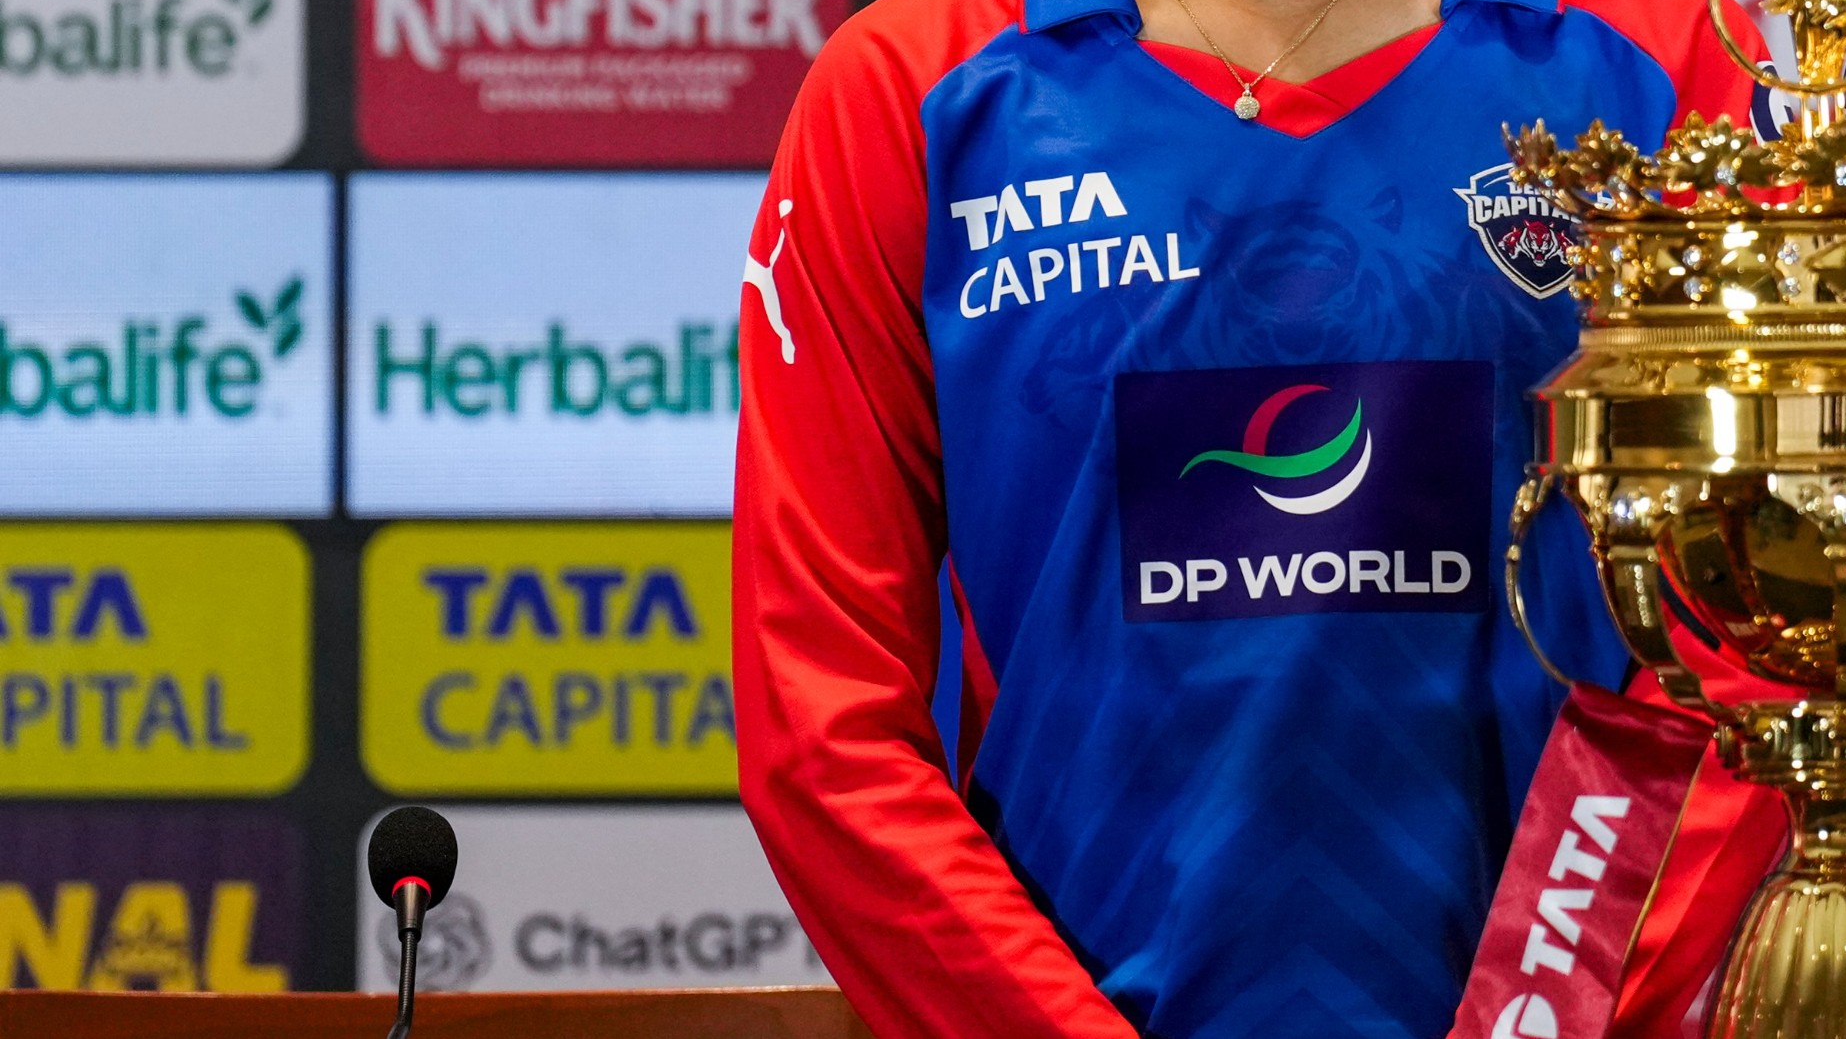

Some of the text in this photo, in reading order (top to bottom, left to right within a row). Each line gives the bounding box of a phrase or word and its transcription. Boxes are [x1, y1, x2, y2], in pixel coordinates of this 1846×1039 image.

[951, 171, 1128, 251] TATA
[959, 232, 1201, 319] CAPITAL
[374, 318, 739, 418] Herbali
[0, 566, 150, 643] TA
[424, 566, 699, 642] TATA
[1139, 550, 1472, 605] DP WORLD
[2, 672, 253, 749] PITAL
[420, 672, 737, 750] CAPITA
[1520, 795, 1631, 977] TATA
